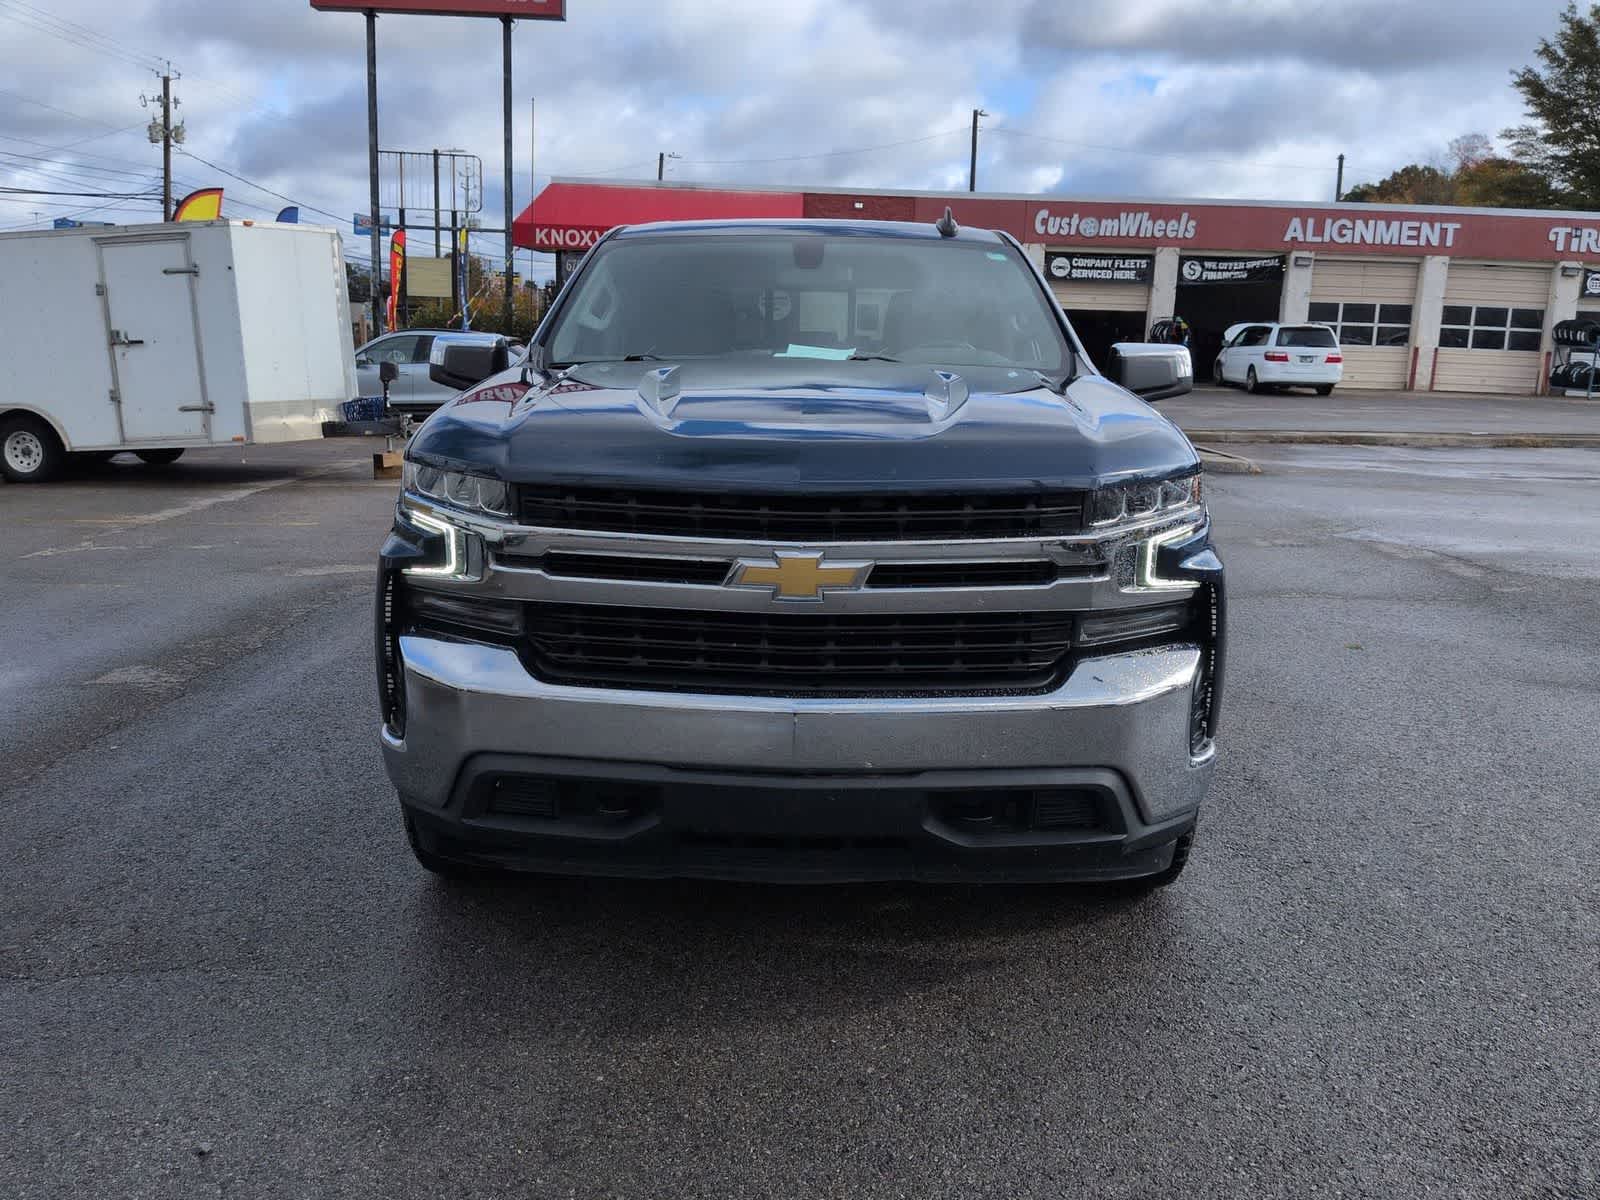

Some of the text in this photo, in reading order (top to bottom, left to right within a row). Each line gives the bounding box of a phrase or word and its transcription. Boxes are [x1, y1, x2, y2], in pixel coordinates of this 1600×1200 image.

[1283, 217, 1462, 248] ALIGNMENT
[1548, 227, 1600, 253] TiR
[1072, 257, 1147, 269] COMPANY FLEETS
[1071, 268, 1137, 280] SERVICED HERE
